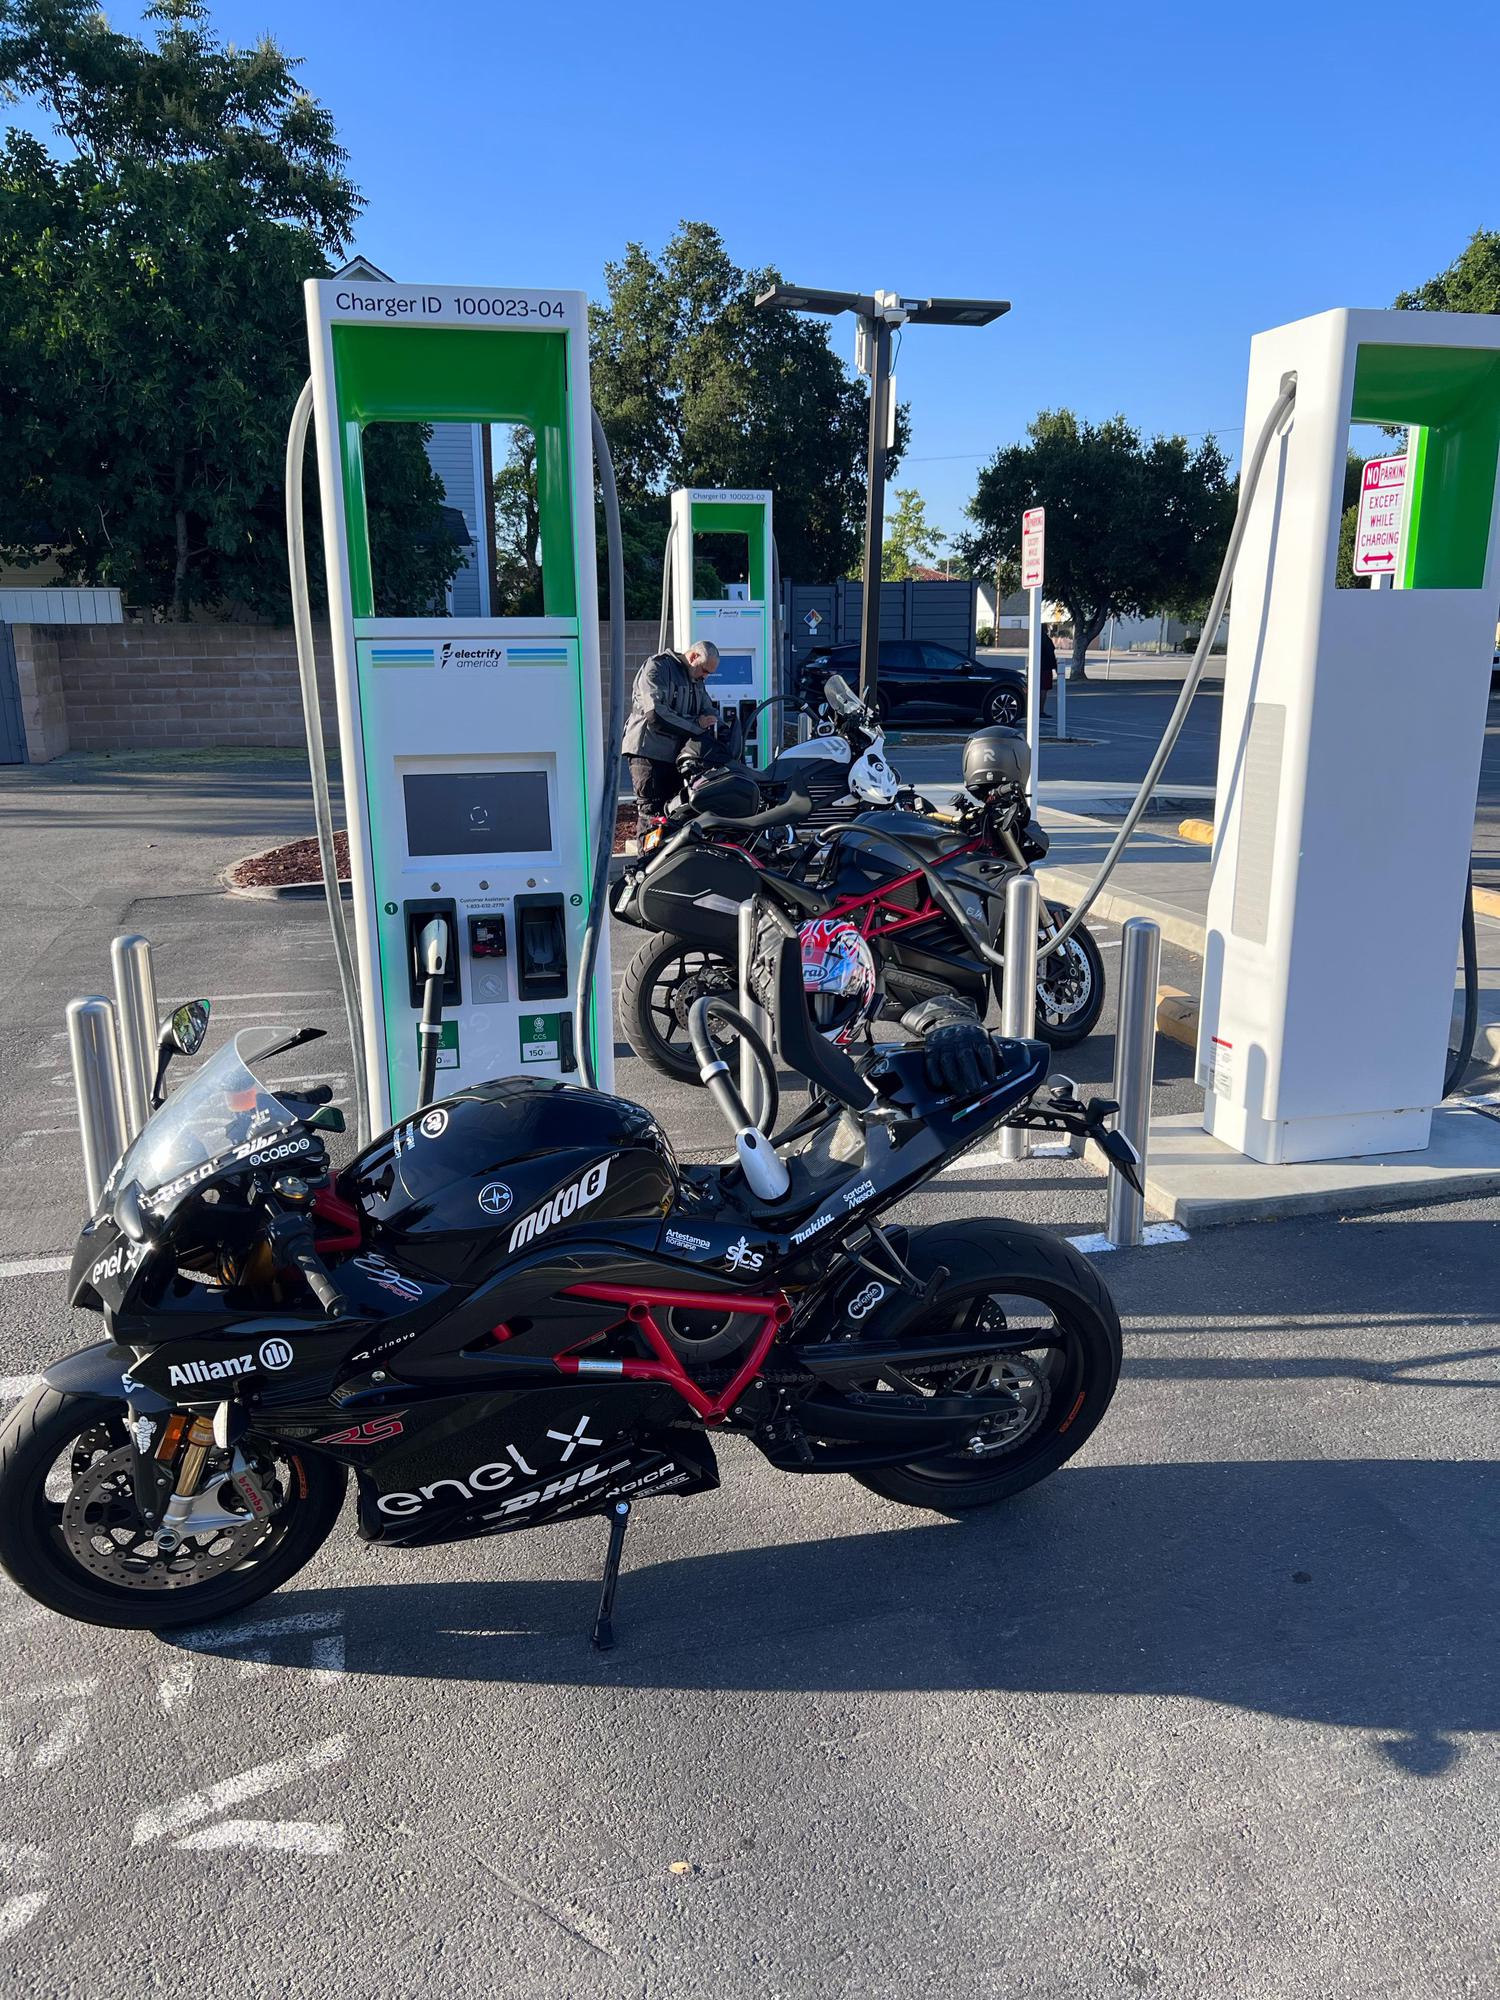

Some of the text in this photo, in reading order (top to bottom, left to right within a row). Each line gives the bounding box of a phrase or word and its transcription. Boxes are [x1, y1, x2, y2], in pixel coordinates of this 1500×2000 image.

[336, 293, 565, 318] Charger ID 100023-04
[1366, 466, 1379, 485] NO
[692, 492, 719, 501] Charger
[1369, 493, 1399, 509] EXCEPT
[1370, 513, 1394, 527] WHILE
[1361, 532, 1399, 547] CHARGING
[455, 649, 501, 660] electrify
[456, 660, 499, 668] america
[532, 1033, 547, 1041] CCS
[528, 1049, 544, 1057] 150
[233, 1134, 278, 1160] Bihr
[260, 1144, 299, 1163] COBO
[842, 1180, 872, 1202] Sartoria
[666, 1228, 711, 1248] Artestampa
[92, 1247, 123, 1285] enel
[372, 1332, 416, 1354] reinova
[167, 1354, 257, 1387] Allianz
[377, 1443, 538, 1516] enel
[500, 1463, 614, 1515] DHL
